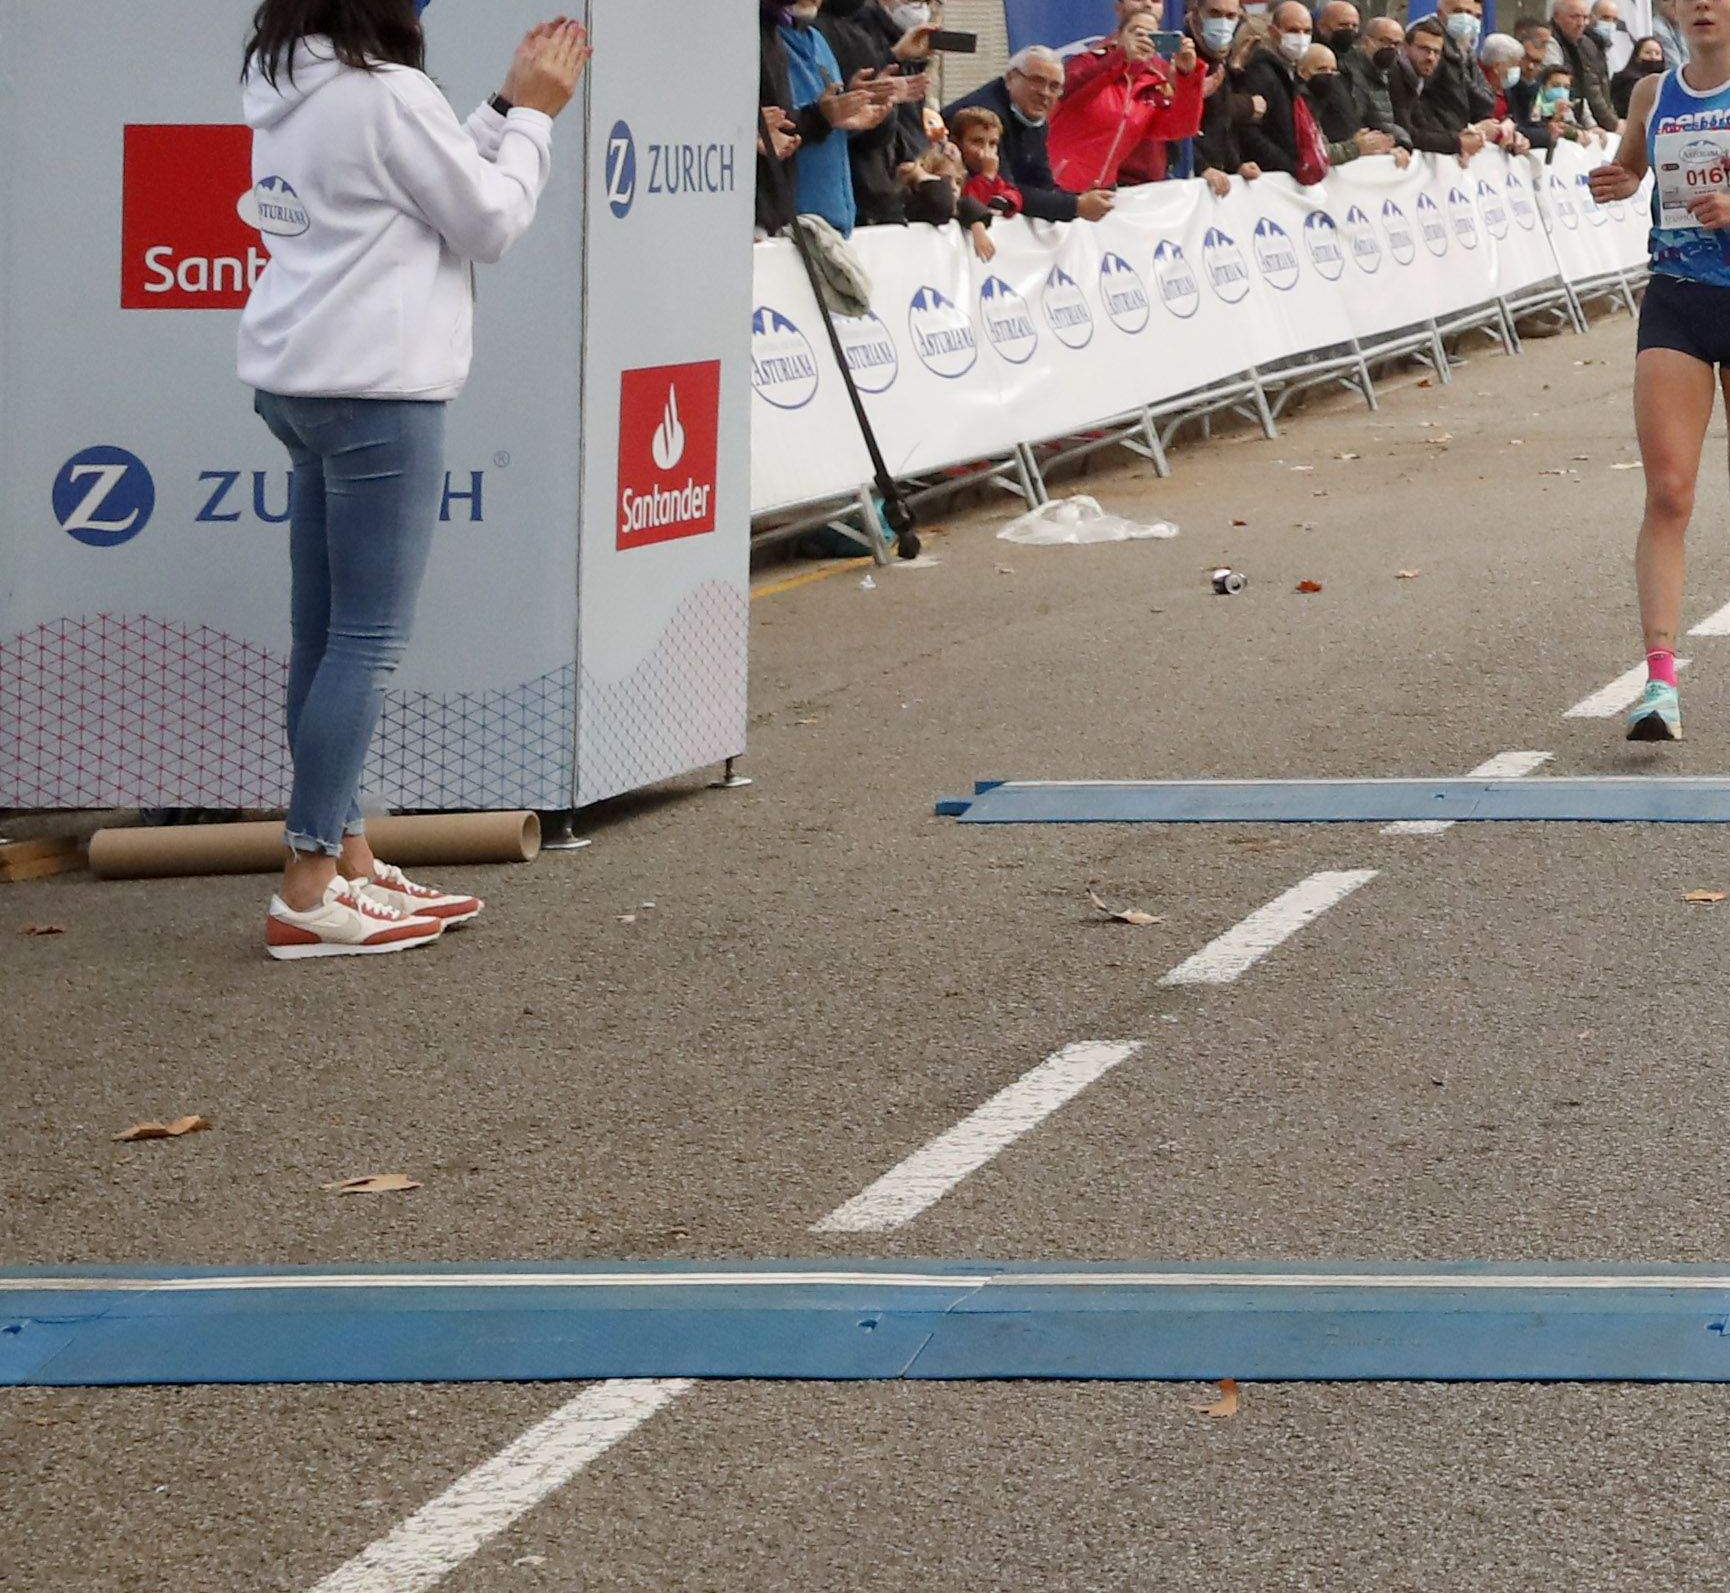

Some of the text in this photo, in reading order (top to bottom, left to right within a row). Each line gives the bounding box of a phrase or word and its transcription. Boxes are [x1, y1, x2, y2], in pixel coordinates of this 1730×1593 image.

[647, 143, 735, 195] ZURICH
[257, 202, 307, 226] STURIANA
[846, 341, 896, 370] STURIANA
[194, 470, 485, 523] ZUH
[621, 480, 711, 533] Santander
